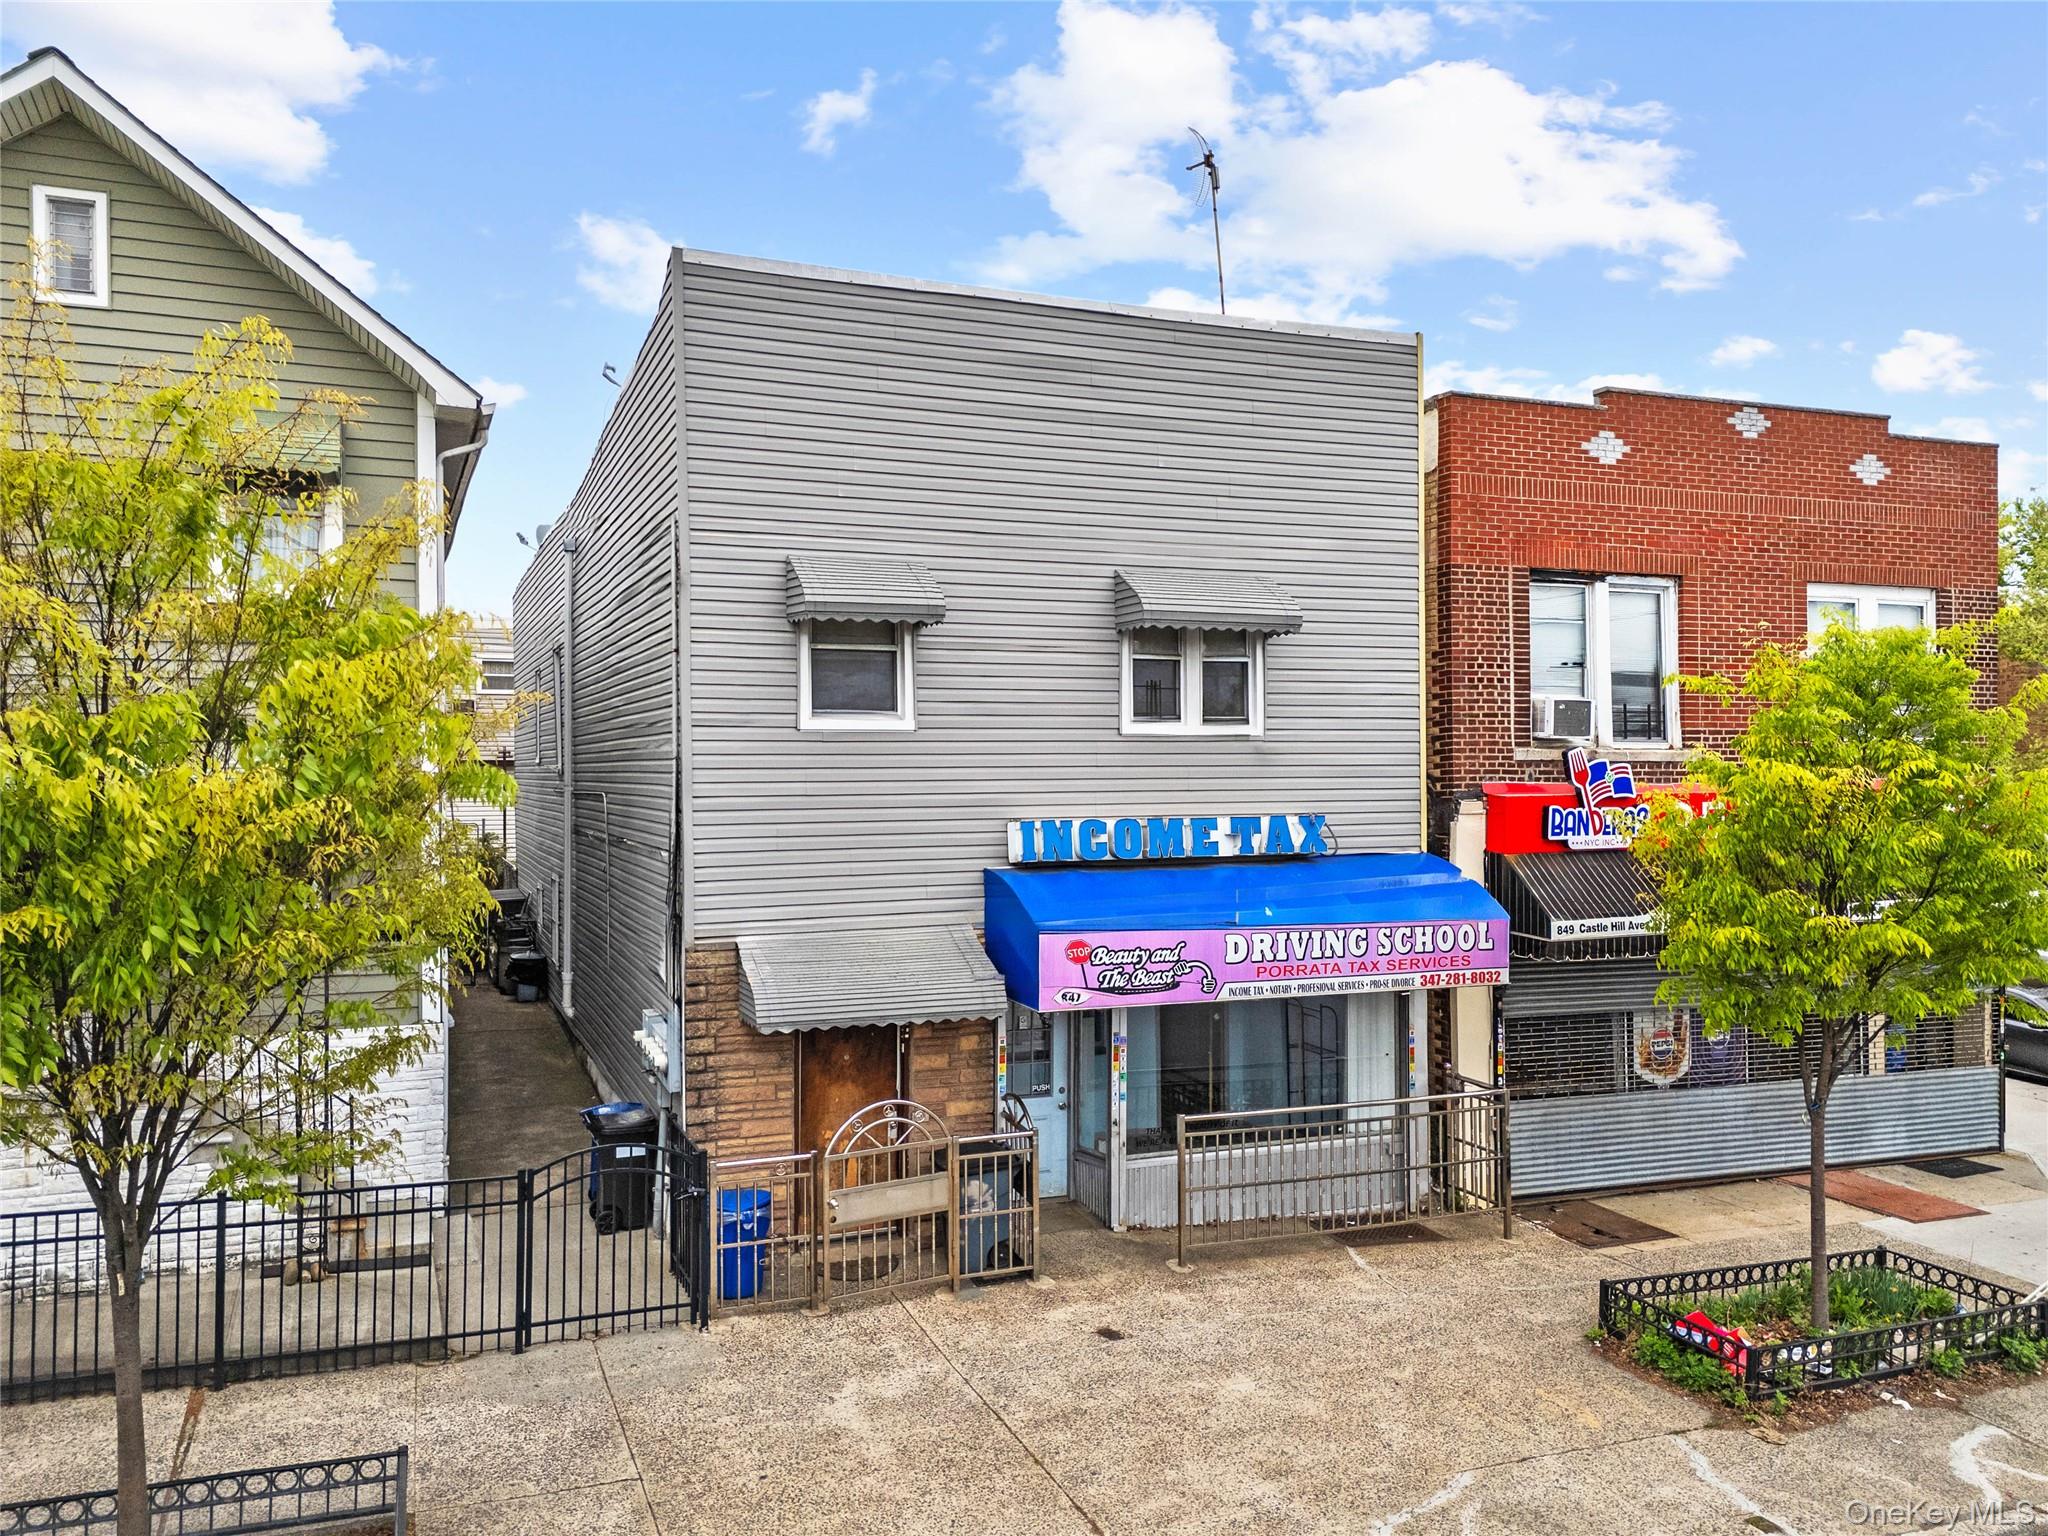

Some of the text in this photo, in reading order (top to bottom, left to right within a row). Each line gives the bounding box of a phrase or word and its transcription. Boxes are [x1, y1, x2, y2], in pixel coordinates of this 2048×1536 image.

[1020, 815, 1328, 862] INCOME TAX
[1584, 838, 1616, 847] NYC INC
[1557, 925, 1574, 935] 849
[1579, 923, 1608, 933] Castle
[1611, 921, 1625, 931] Hill
[1067, 946, 1091, 958] STOP
[1224, 921, 1494, 964] DRIVING SCHOOL
[1091, 942, 1187, 968] Beauty and
[1256, 955, 1471, 978] PORRATA TAX SERVICES
[1100, 968, 1175, 988] The Beast
[1228, 976, 1415, 997] INCOME TAX NOTARY PROFESIONAL SERVICES PRO-SE DIVORCE
[1420, 970, 1501, 987] 347-281-8032
[1032, 1083, 1051, 1092] PUSH
